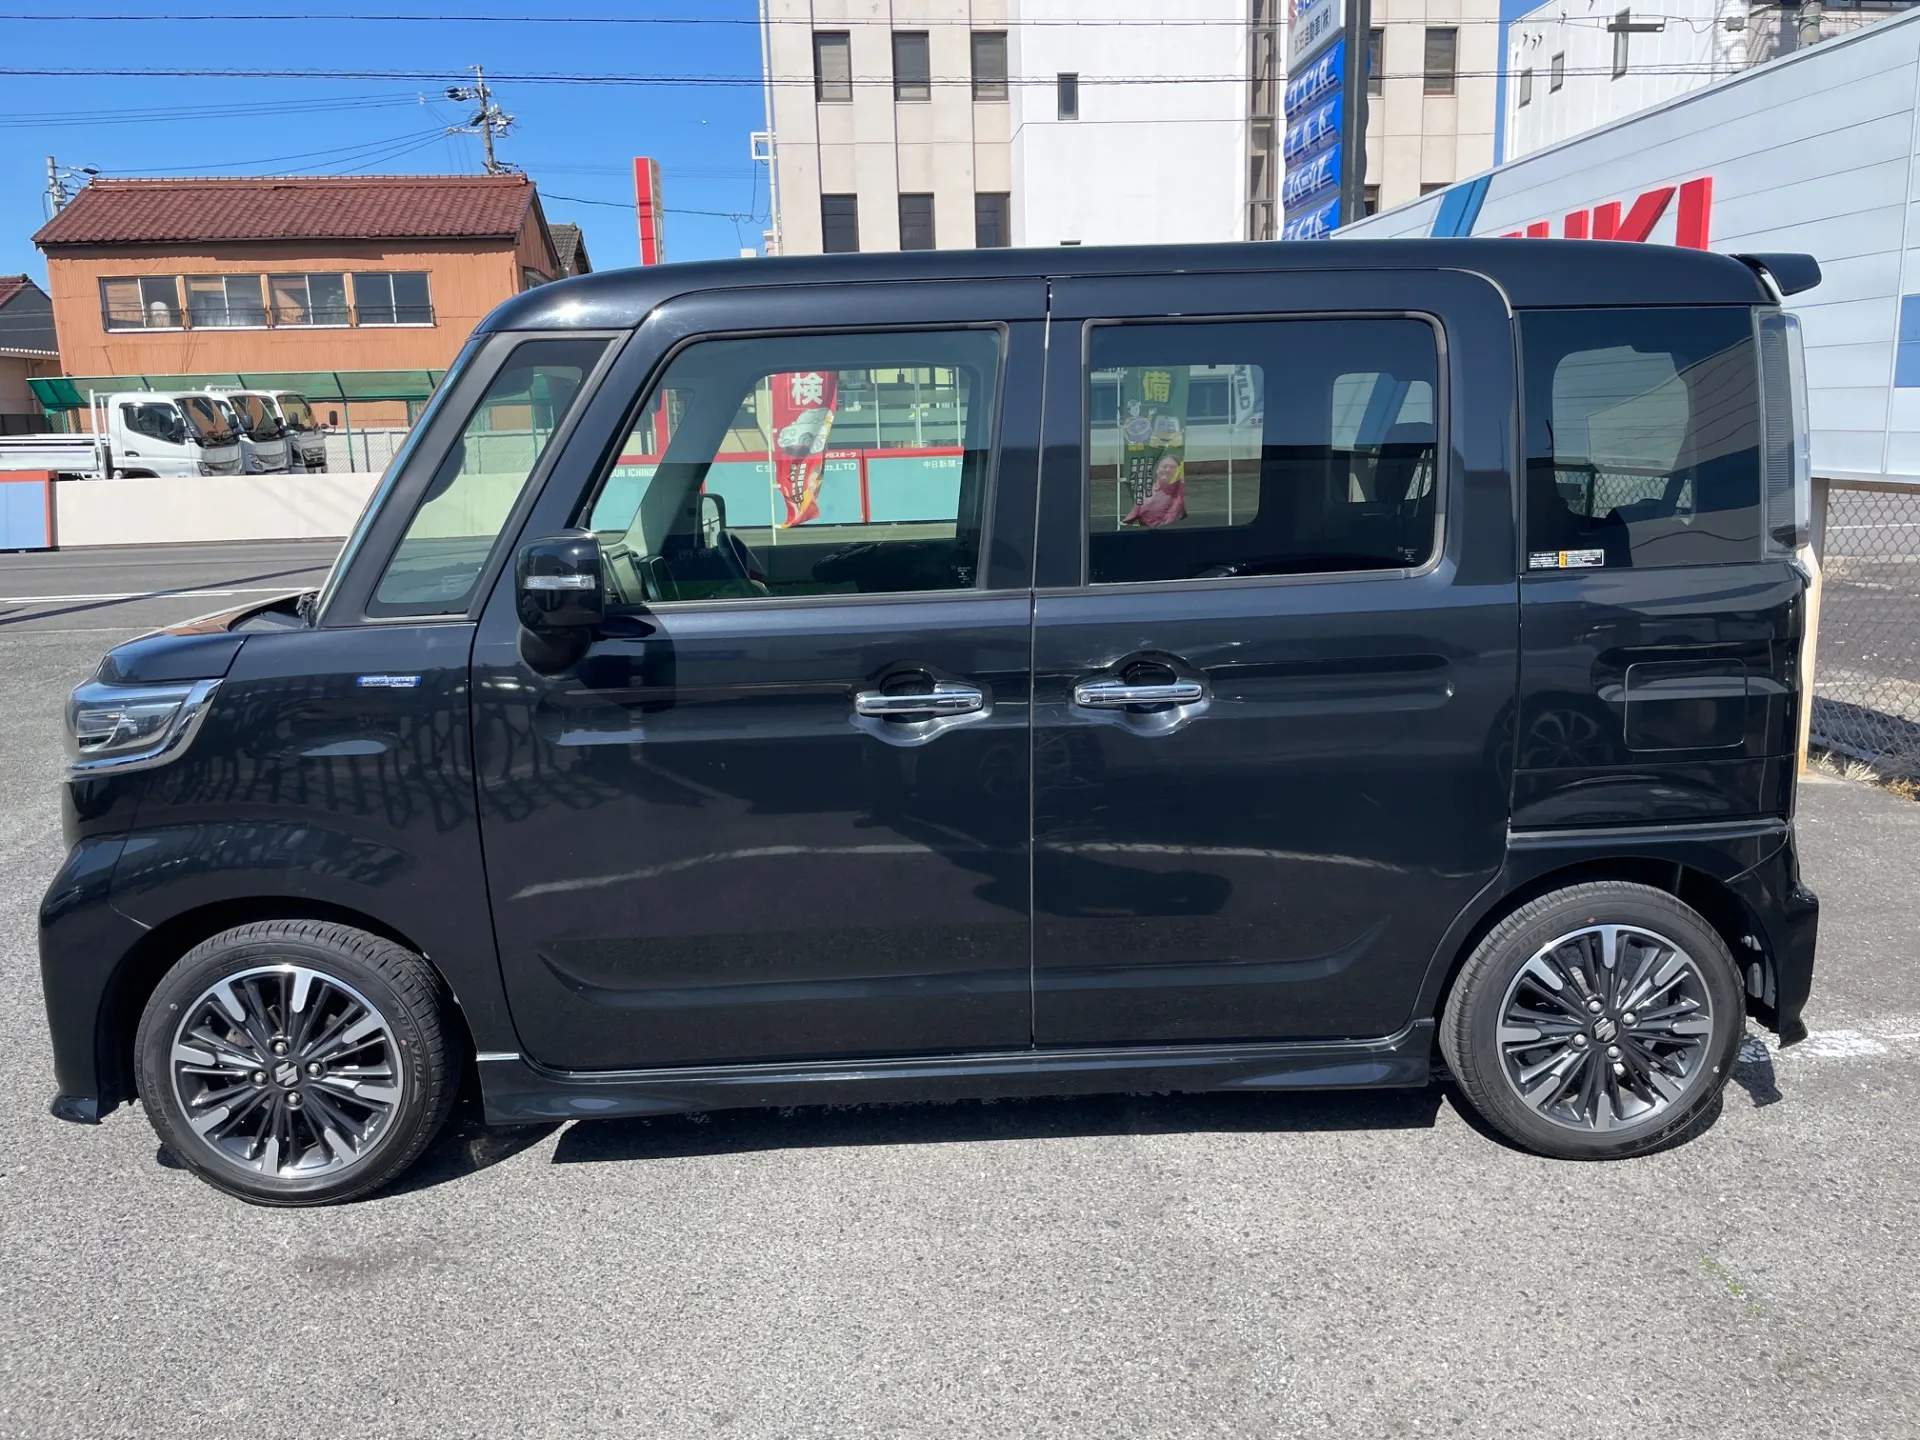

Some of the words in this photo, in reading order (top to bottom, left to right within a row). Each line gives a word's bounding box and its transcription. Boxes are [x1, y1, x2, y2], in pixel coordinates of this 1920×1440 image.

[1288, 57, 1329, 106] ワゴンR
[1289, 107, 1326, 158] アルト
[791, 372, 824, 406] 検
[1143, 371, 1171, 402] 備
